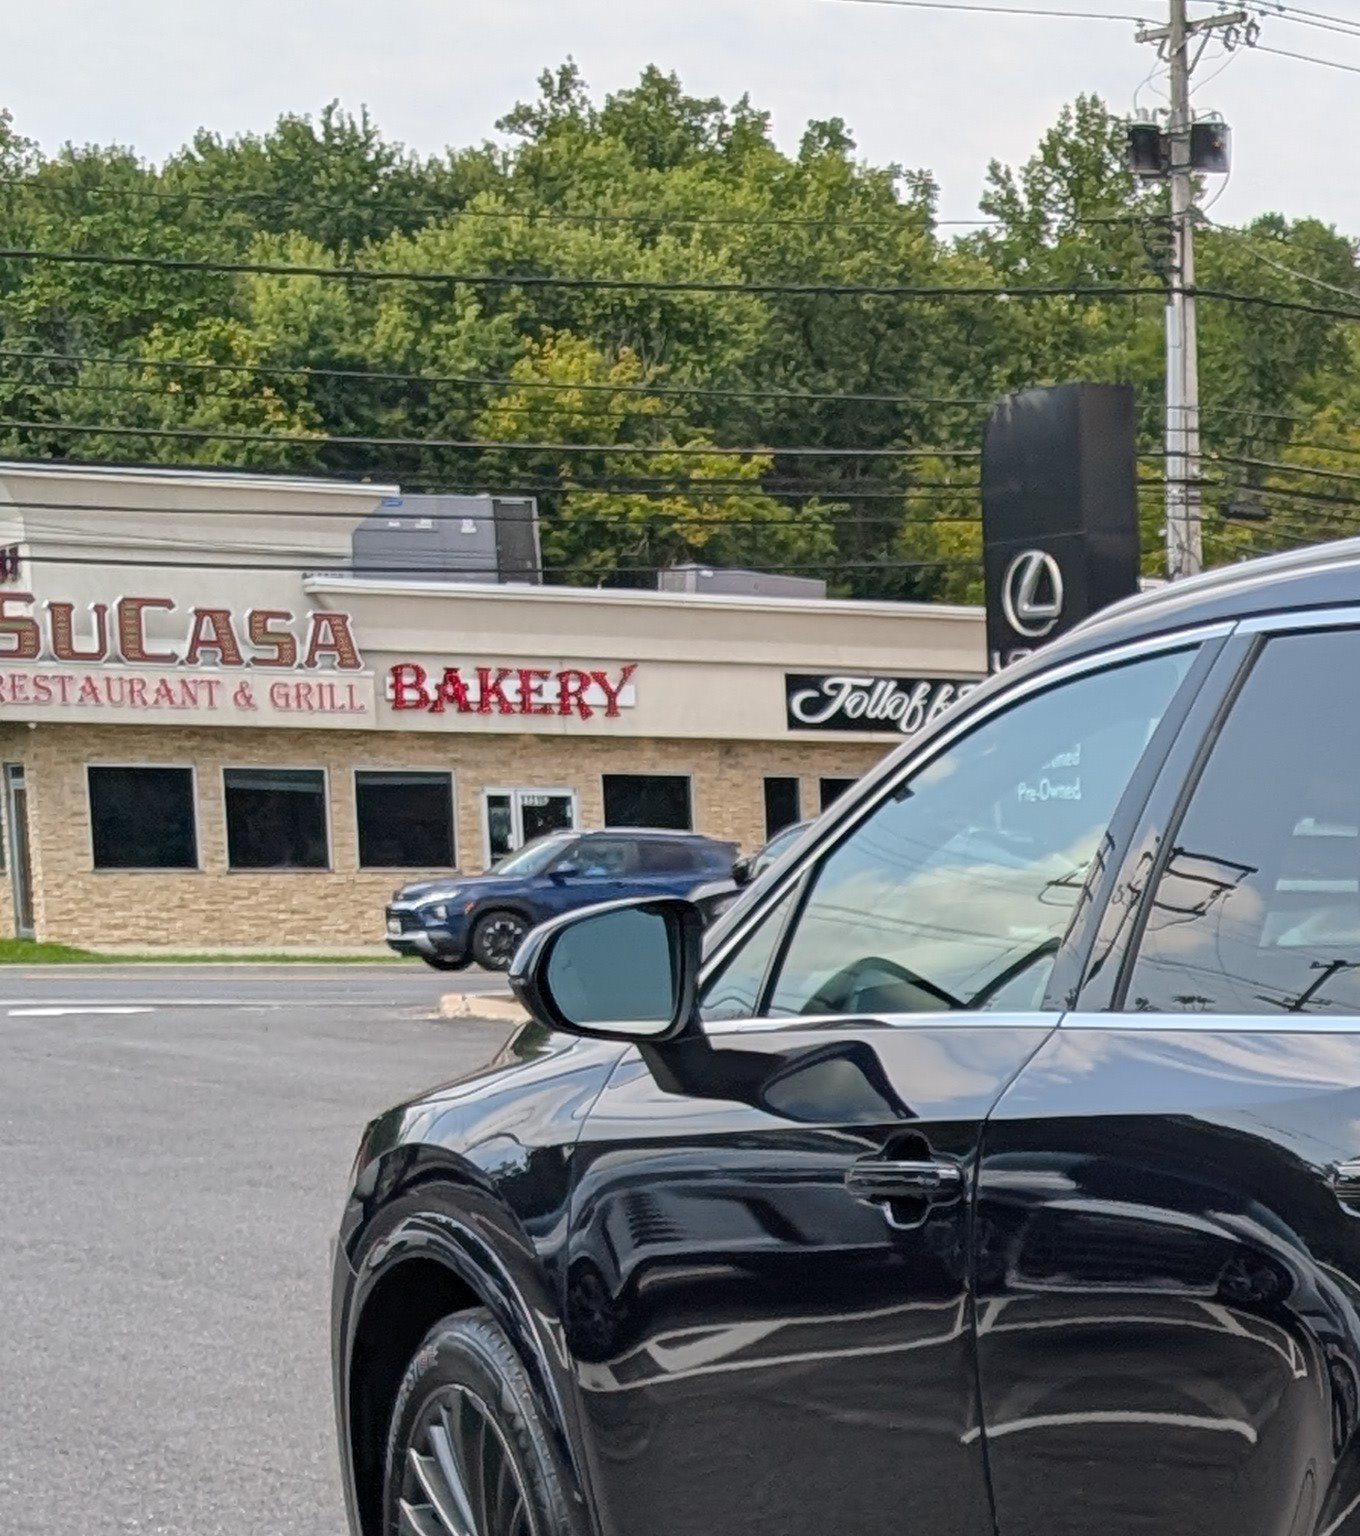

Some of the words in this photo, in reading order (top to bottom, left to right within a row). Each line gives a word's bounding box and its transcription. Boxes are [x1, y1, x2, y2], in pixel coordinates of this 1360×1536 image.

[0, 672, 221, 710] ESTAURANT
[233, 682, 256, 710] &
[270, 681, 367, 712] GRILL
[390, 663, 638, 720] BAKERY
